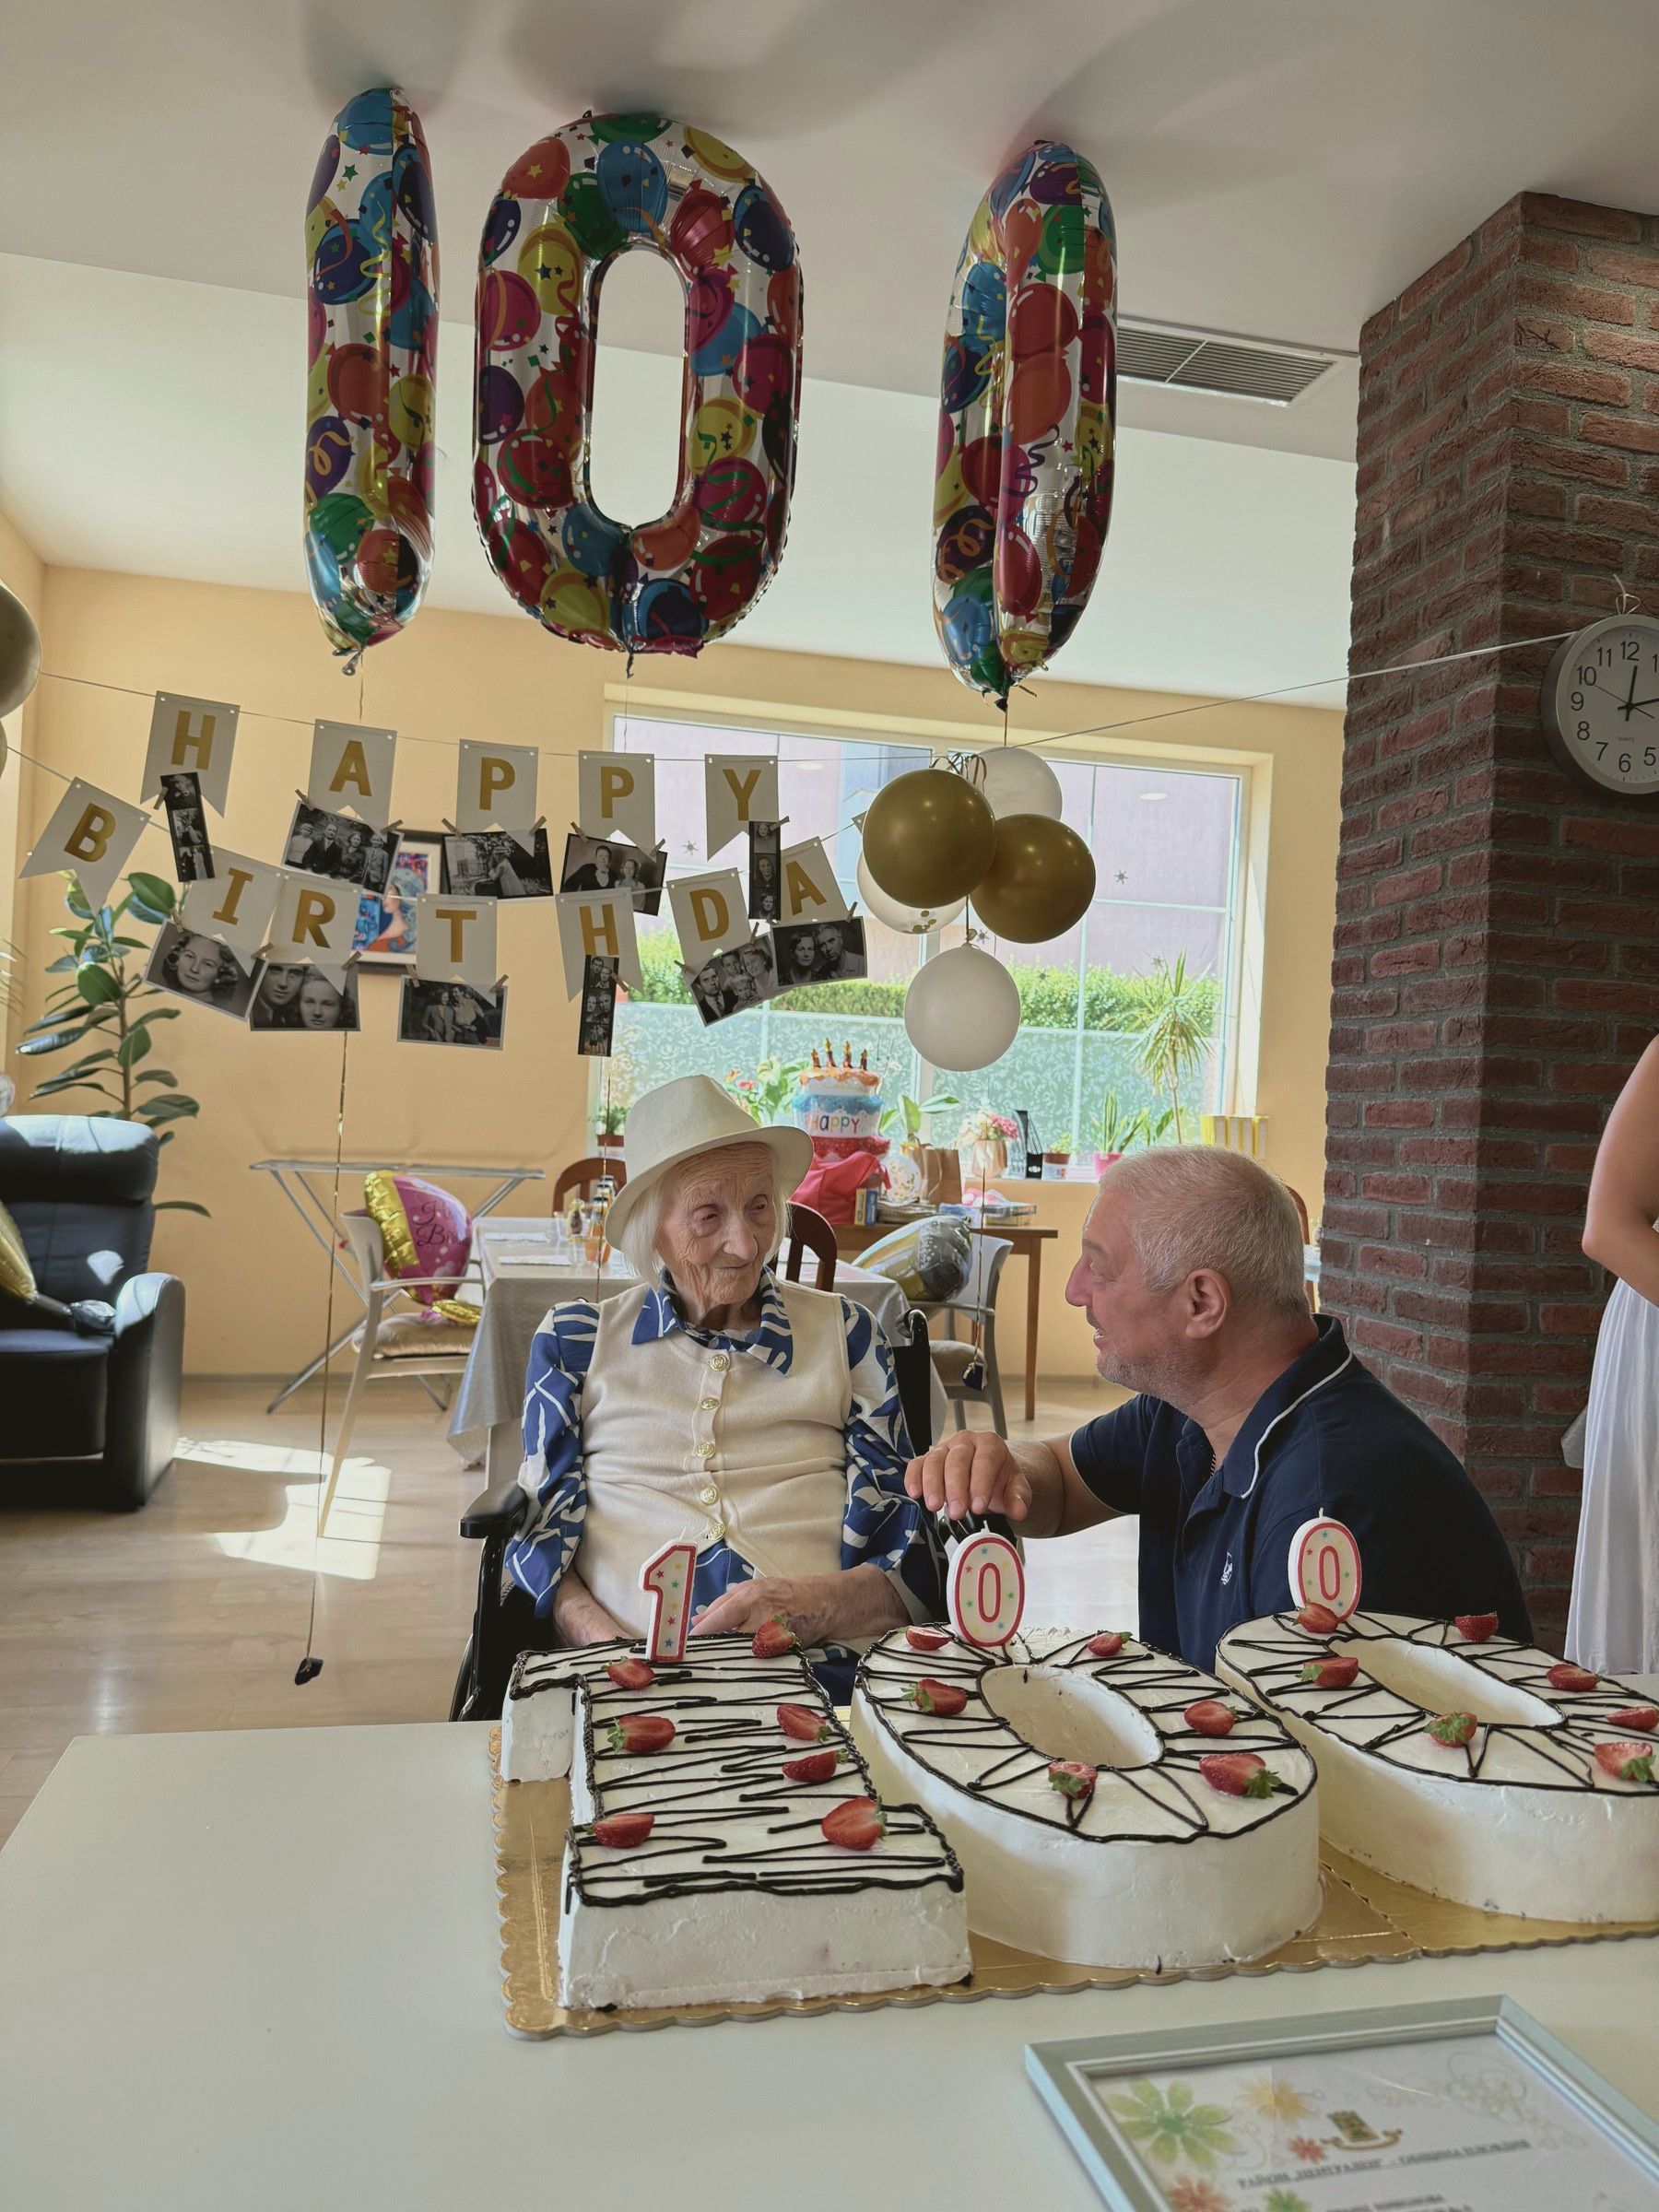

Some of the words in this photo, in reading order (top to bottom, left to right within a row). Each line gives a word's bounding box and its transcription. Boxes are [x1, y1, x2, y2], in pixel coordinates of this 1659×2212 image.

[1596, 647, 1613, 667] 11
[1620, 641, 1640, 662] 12
[1652, 653, 1658, 673] 1
[1576, 665, 1597, 687] 10
[1571, 691, 1584, 711] 9
[1577, 721, 1590, 740] 8
[1595, 741, 1609, 761] 7
[1643, 747, 1656, 766] 5
[171, 709, 762, 823] HAPPY
[1618, 753, 1631, 772] 6
[62, 802, 828, 964] BIRTHDA
